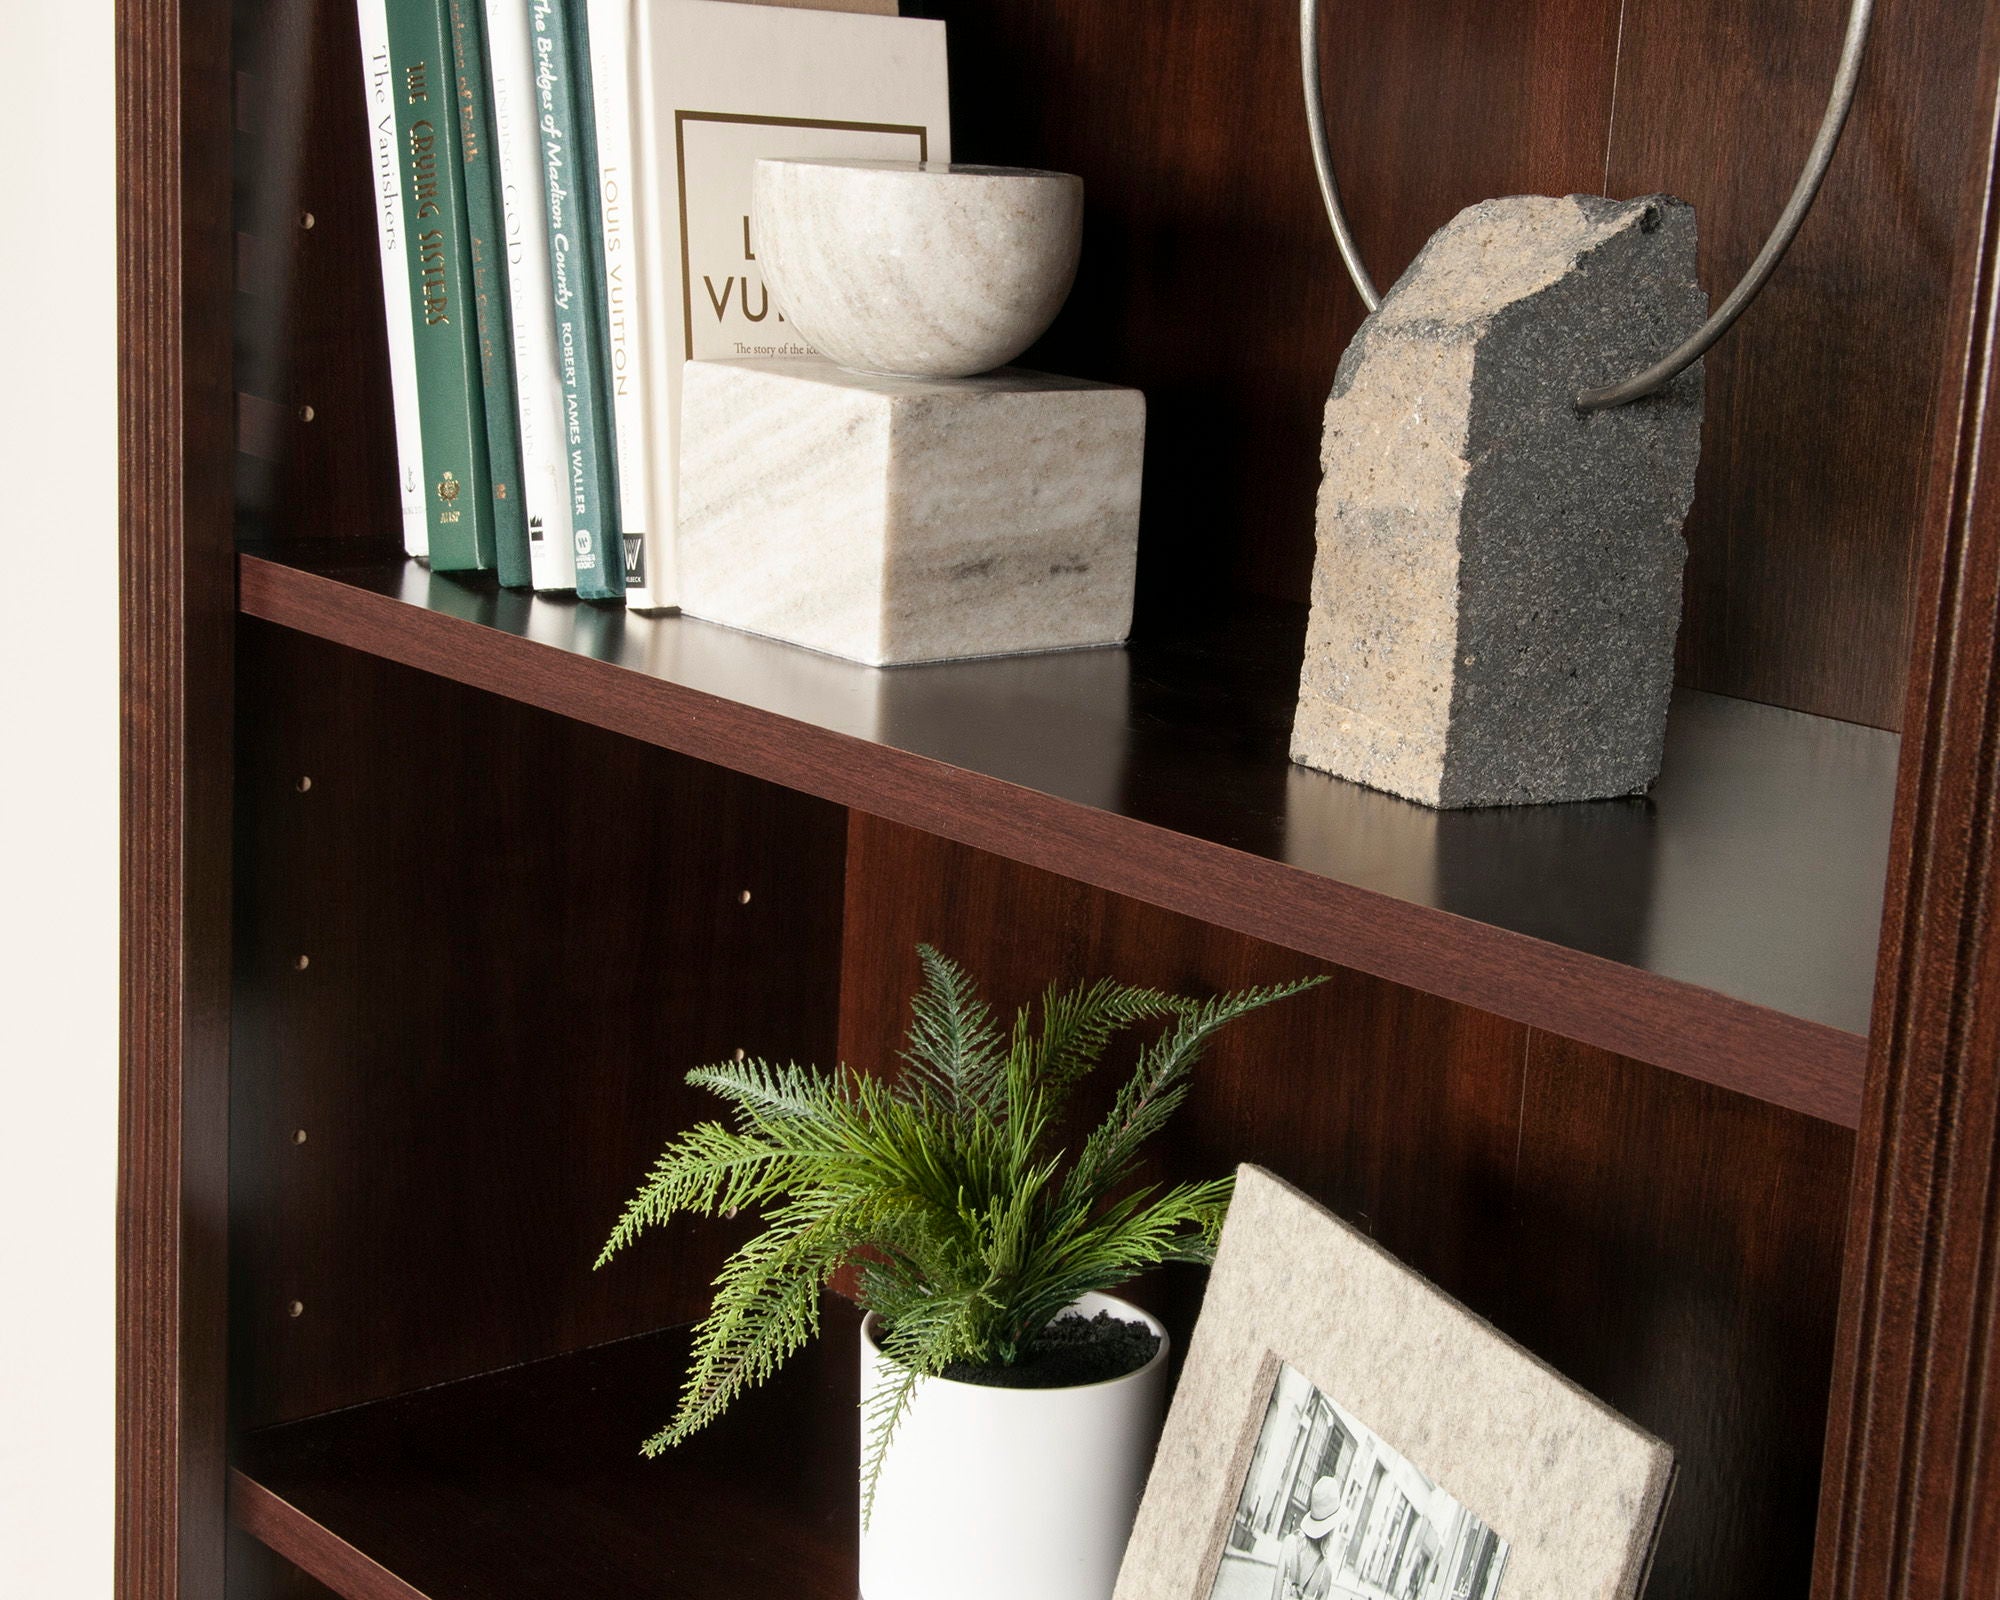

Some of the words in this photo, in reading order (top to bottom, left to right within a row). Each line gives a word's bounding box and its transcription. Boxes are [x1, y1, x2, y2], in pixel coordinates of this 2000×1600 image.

[372, 45, 390, 104] The
[536, 36, 558, 108] Bridges
[541, 113, 562, 140] of
[378, 114, 399, 251] Vanishers
[410, 120, 440, 219] CRYING
[547, 140, 567, 230] Madison
[603, 167, 622, 253] LOUIS
[418, 229, 450, 327] SISTERS
[555, 233, 573, 310] County
[561, 321, 577, 388] ROBERT
[609, 264, 629, 396] VUITTON
[733, 342, 751, 354] The
[753, 344, 776, 358] story
[778, 342, 789, 354] of
[790, 343, 804, 354] the
[566, 393, 582, 445] JAMES
[571, 449, 586, 516] WALLER
